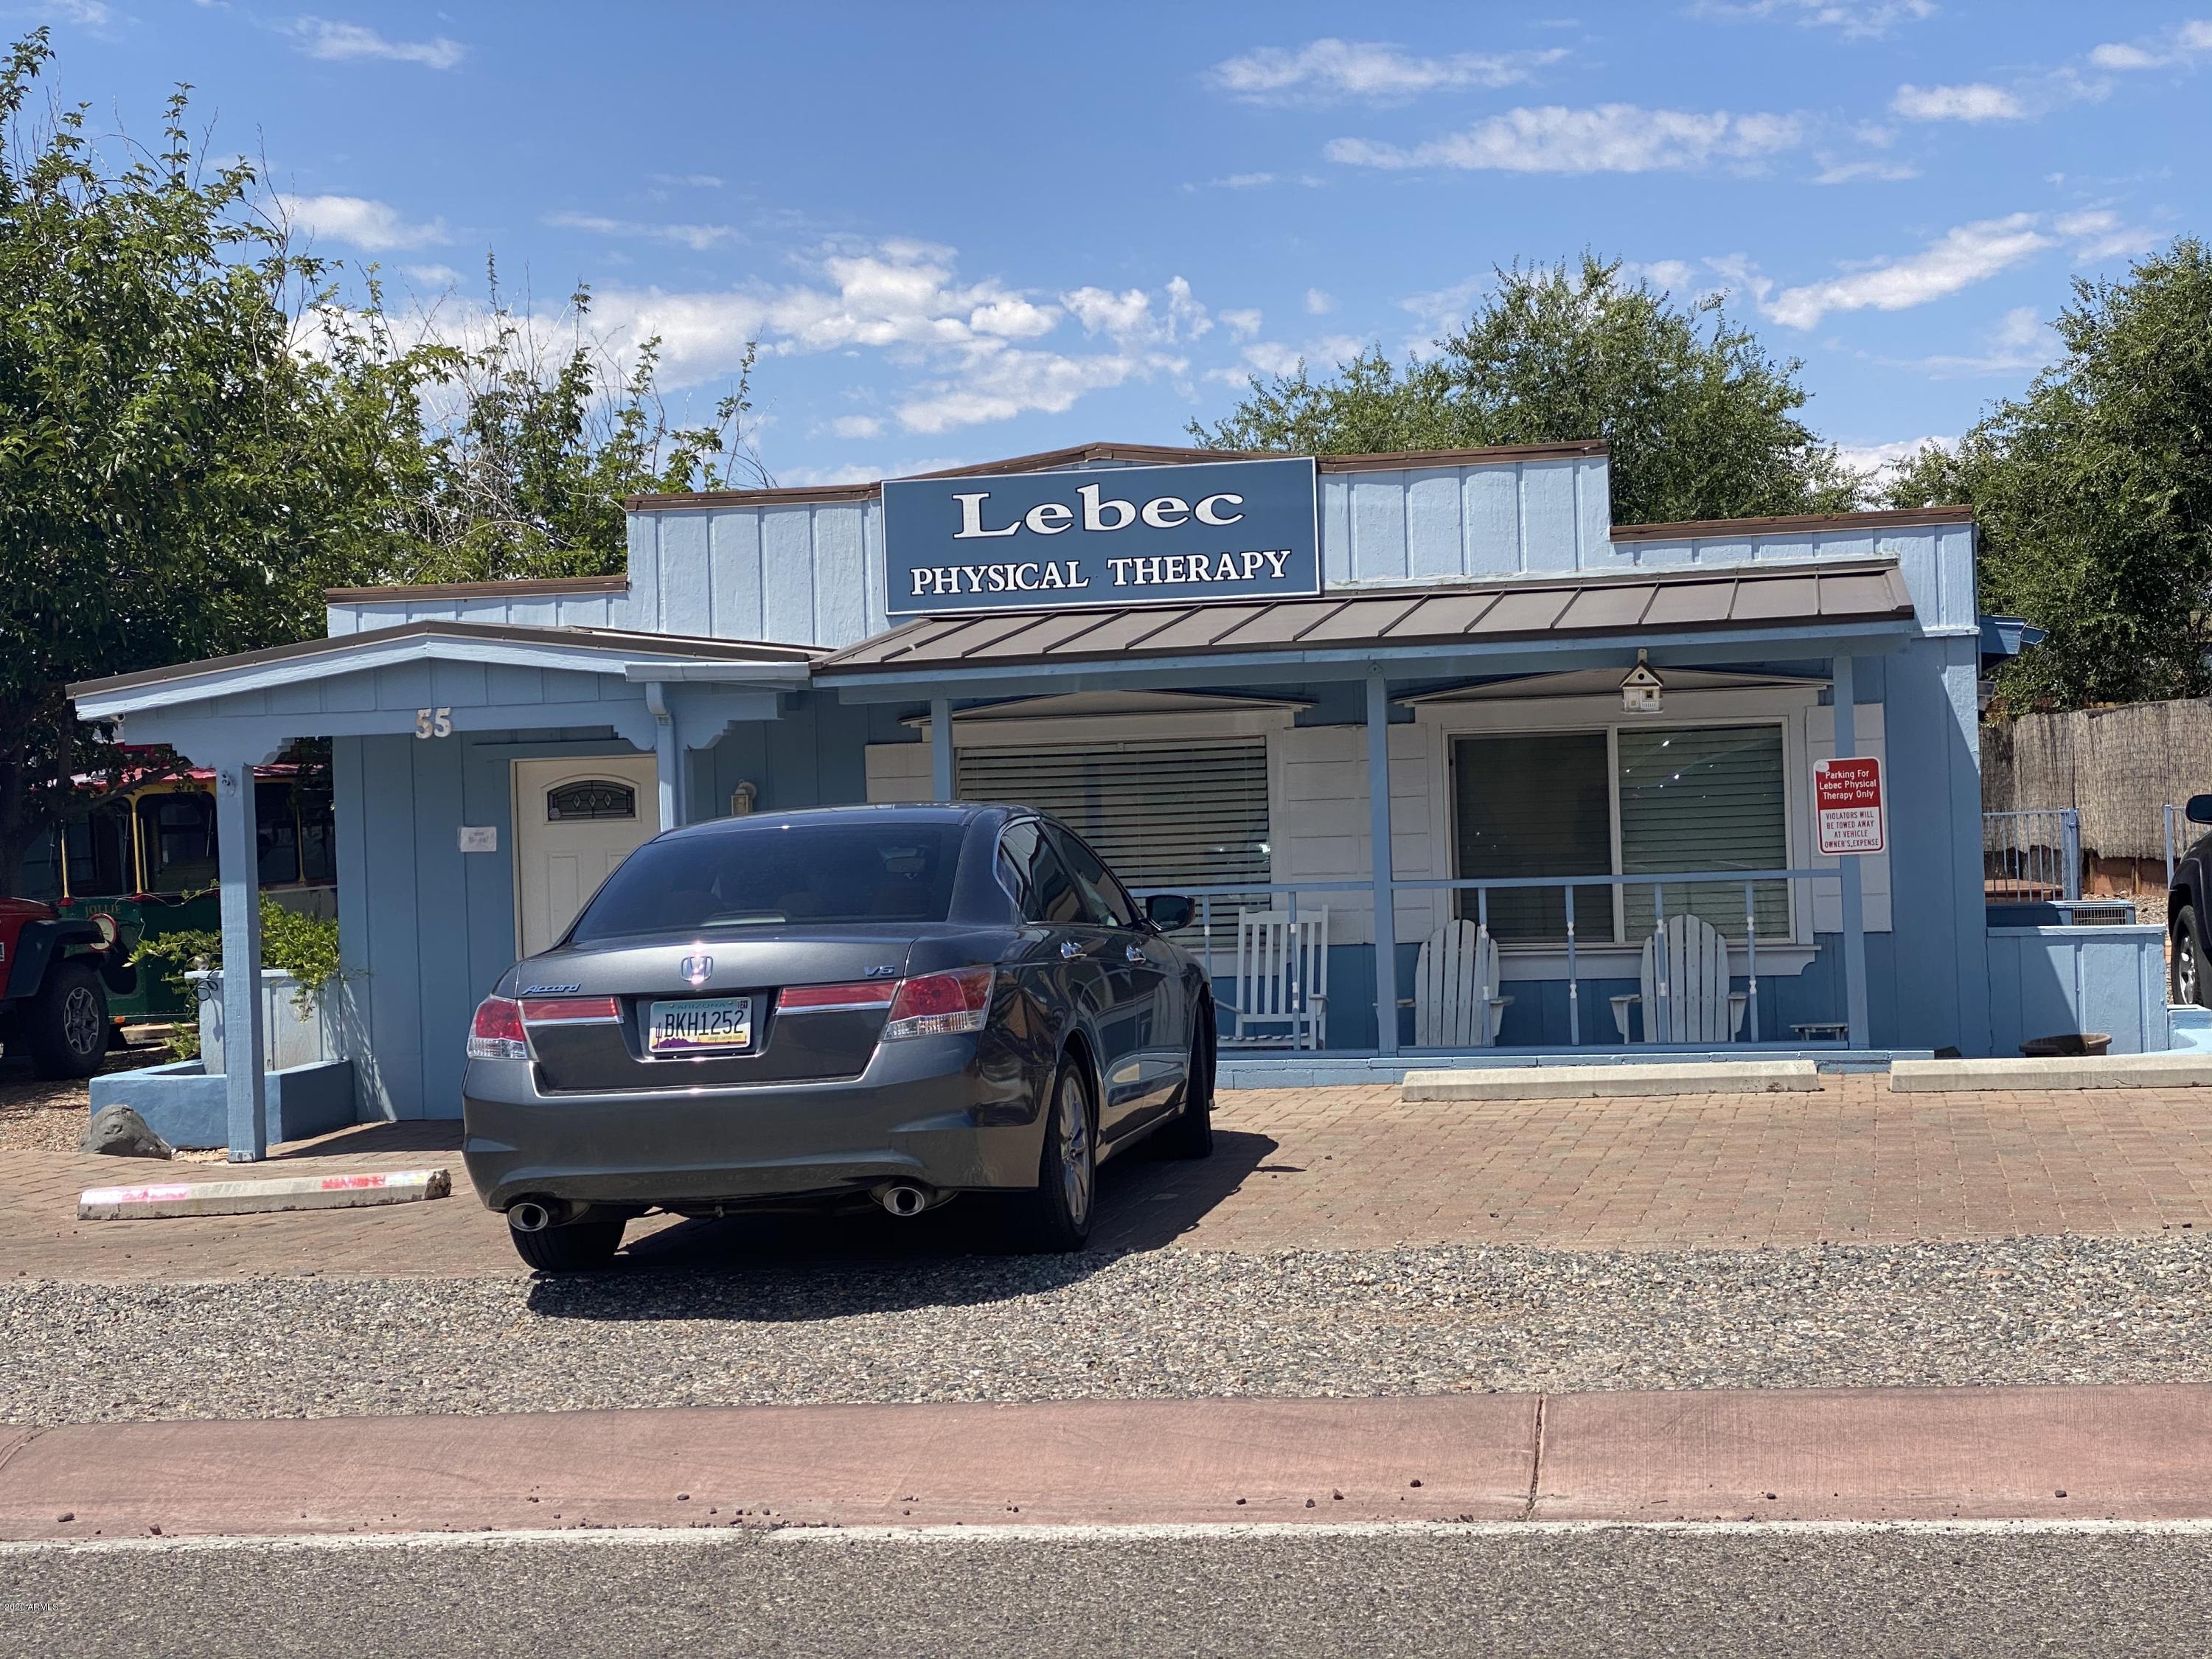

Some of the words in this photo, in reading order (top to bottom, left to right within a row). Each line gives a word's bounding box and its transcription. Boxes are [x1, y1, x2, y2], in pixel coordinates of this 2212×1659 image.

[952, 483, 1246, 539] Lebec
[910, 560, 1090, 596] PHYSICAL
[1107, 549, 1292, 587] THERAPY
[415, 707, 452, 739] 55
[1825, 771, 1855, 779] Parking
[1857, 769, 1870, 777] For
[1819, 782, 1842, 790] Lebec
[1844, 779, 1877, 789] Physical
[1823, 791, 1854, 801] Therapy
[1856, 790, 1874, 799] Only
[1826, 812, 1857, 820] VIOLATORS
[1843, 830, 1868, 838] VEHICLE
[1852, 838, 1879, 846] EXPENSE
[863, 966, 895, 976] V6
[521, 982, 581, 995] Accord
[664, 1010, 744, 1037] BKH1252
